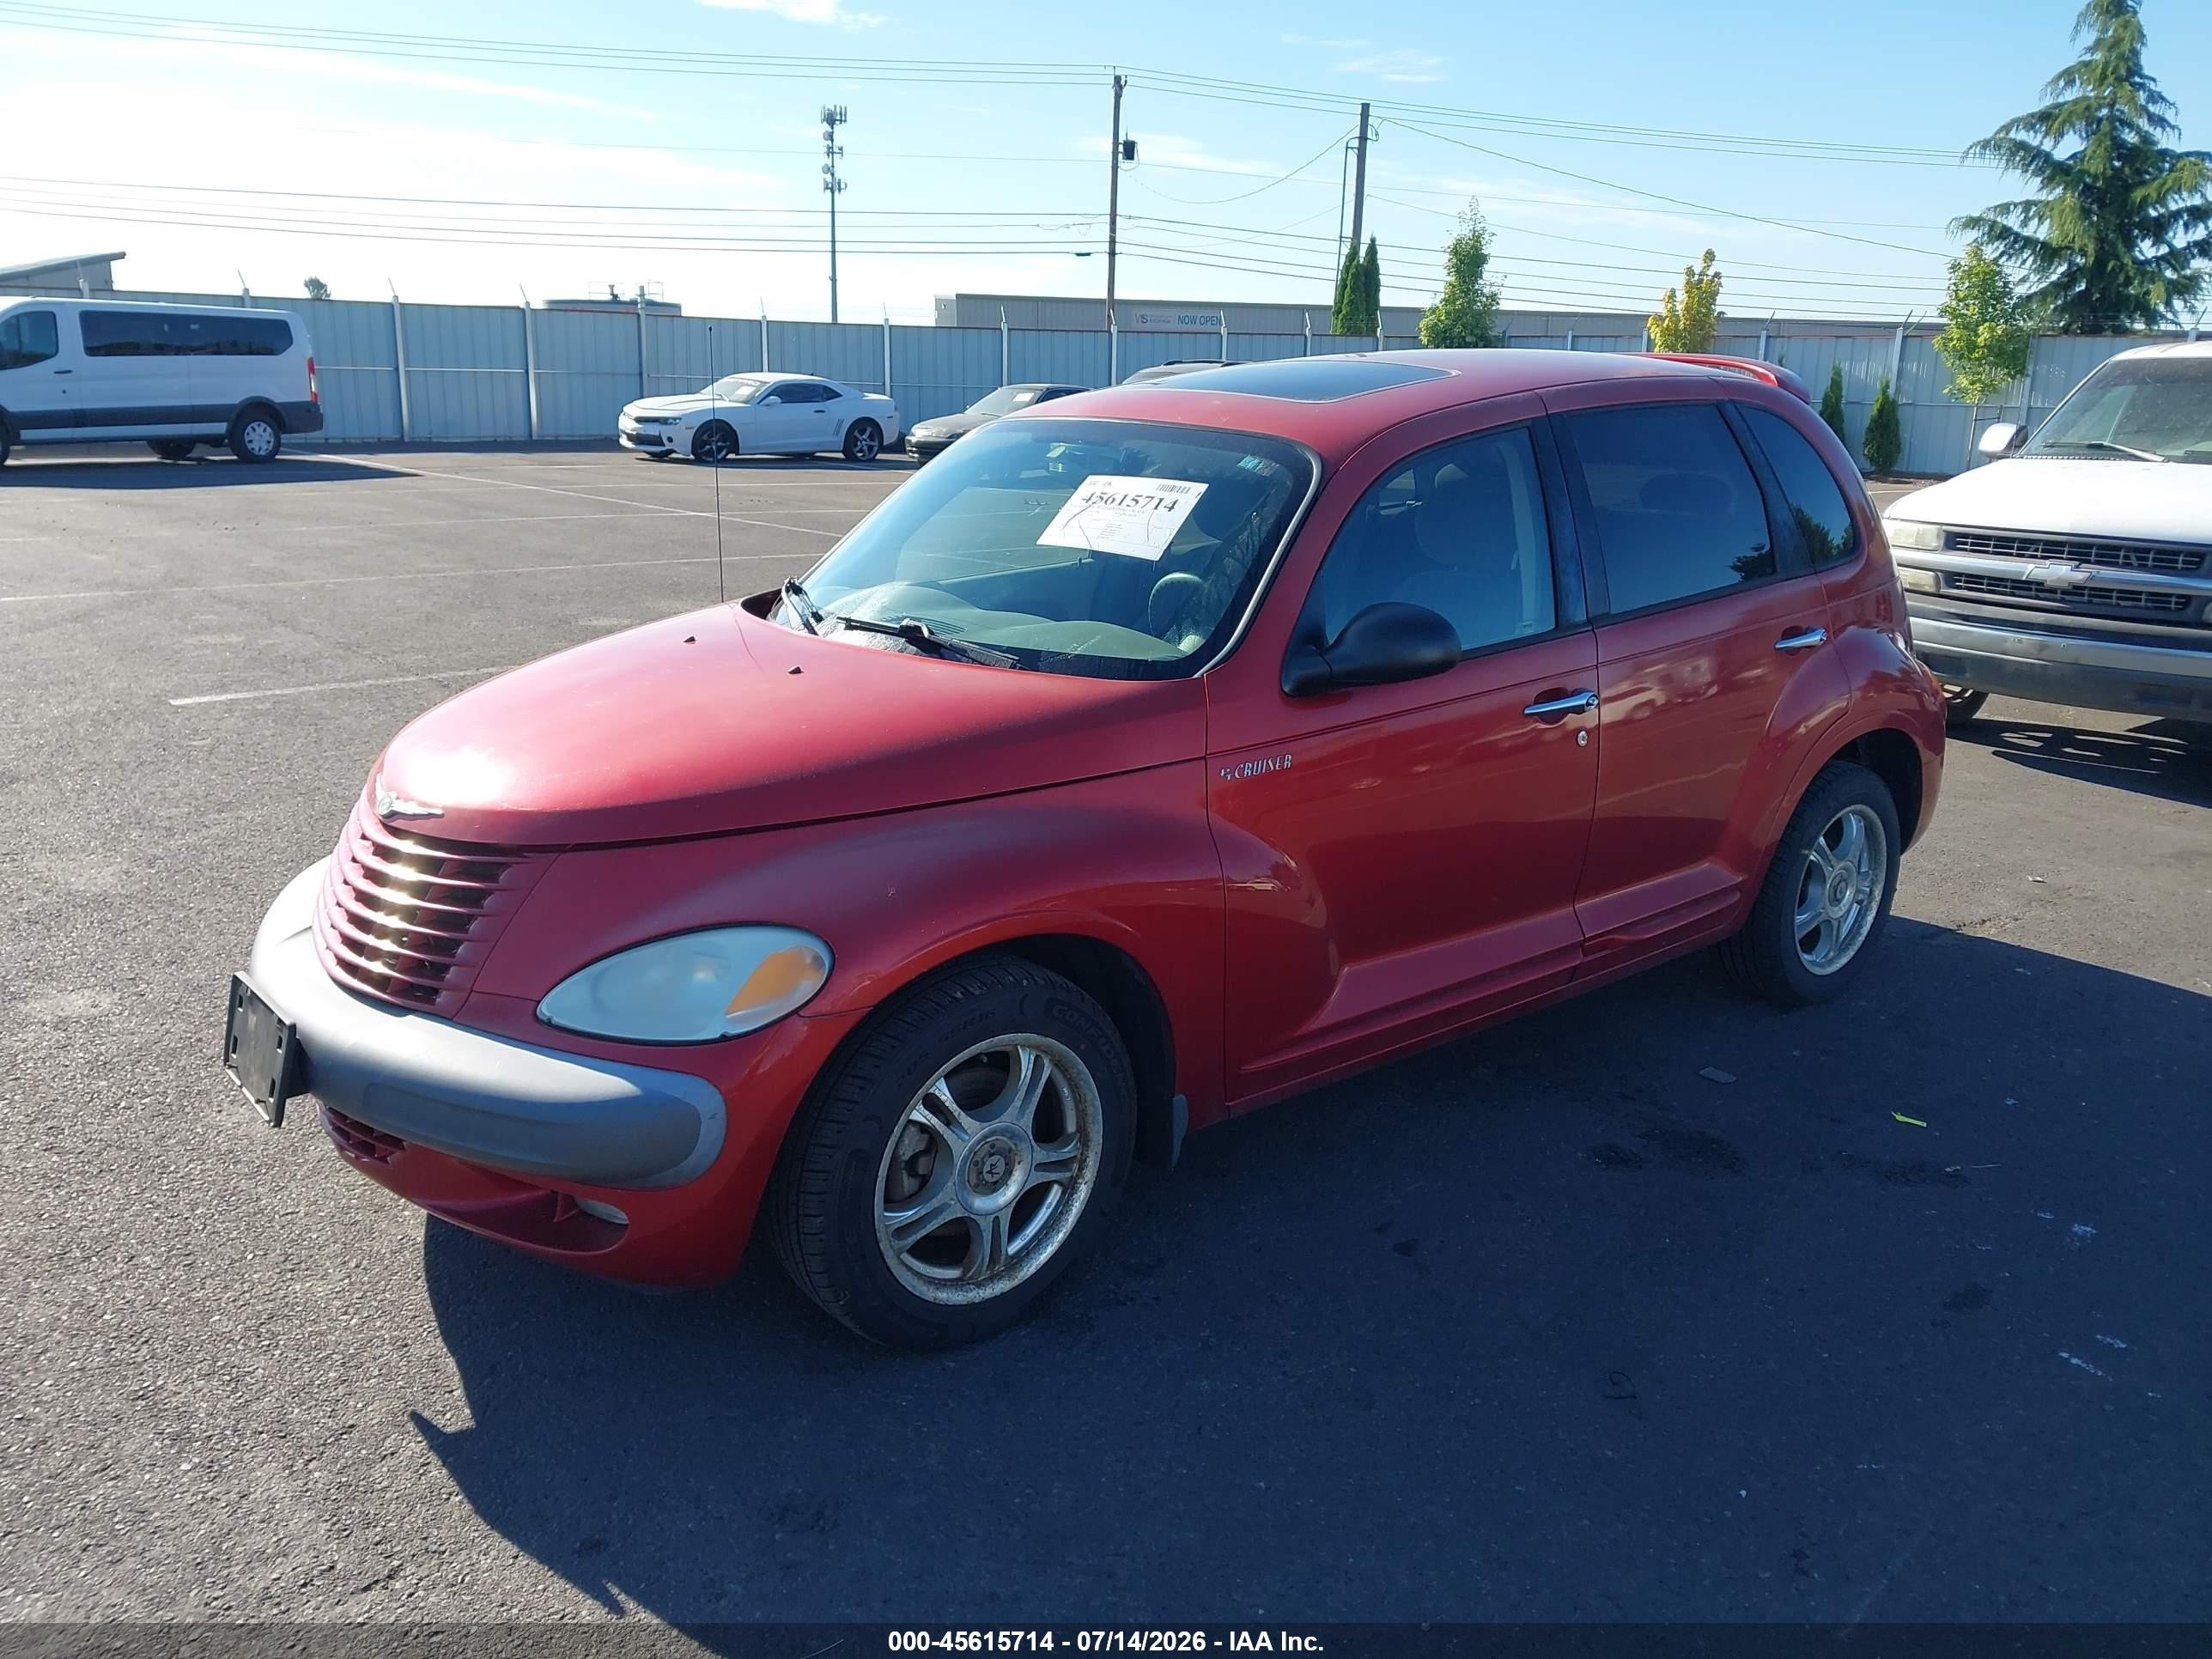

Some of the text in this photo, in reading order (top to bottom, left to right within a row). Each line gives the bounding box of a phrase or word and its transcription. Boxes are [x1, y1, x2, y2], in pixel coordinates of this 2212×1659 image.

[1178, 314, 1197, 325] NOW
[1199, 314, 1222, 326] OPEN
[1081, 491, 1179, 513] 45615714
[1234, 754, 1292, 779] CRUISER
